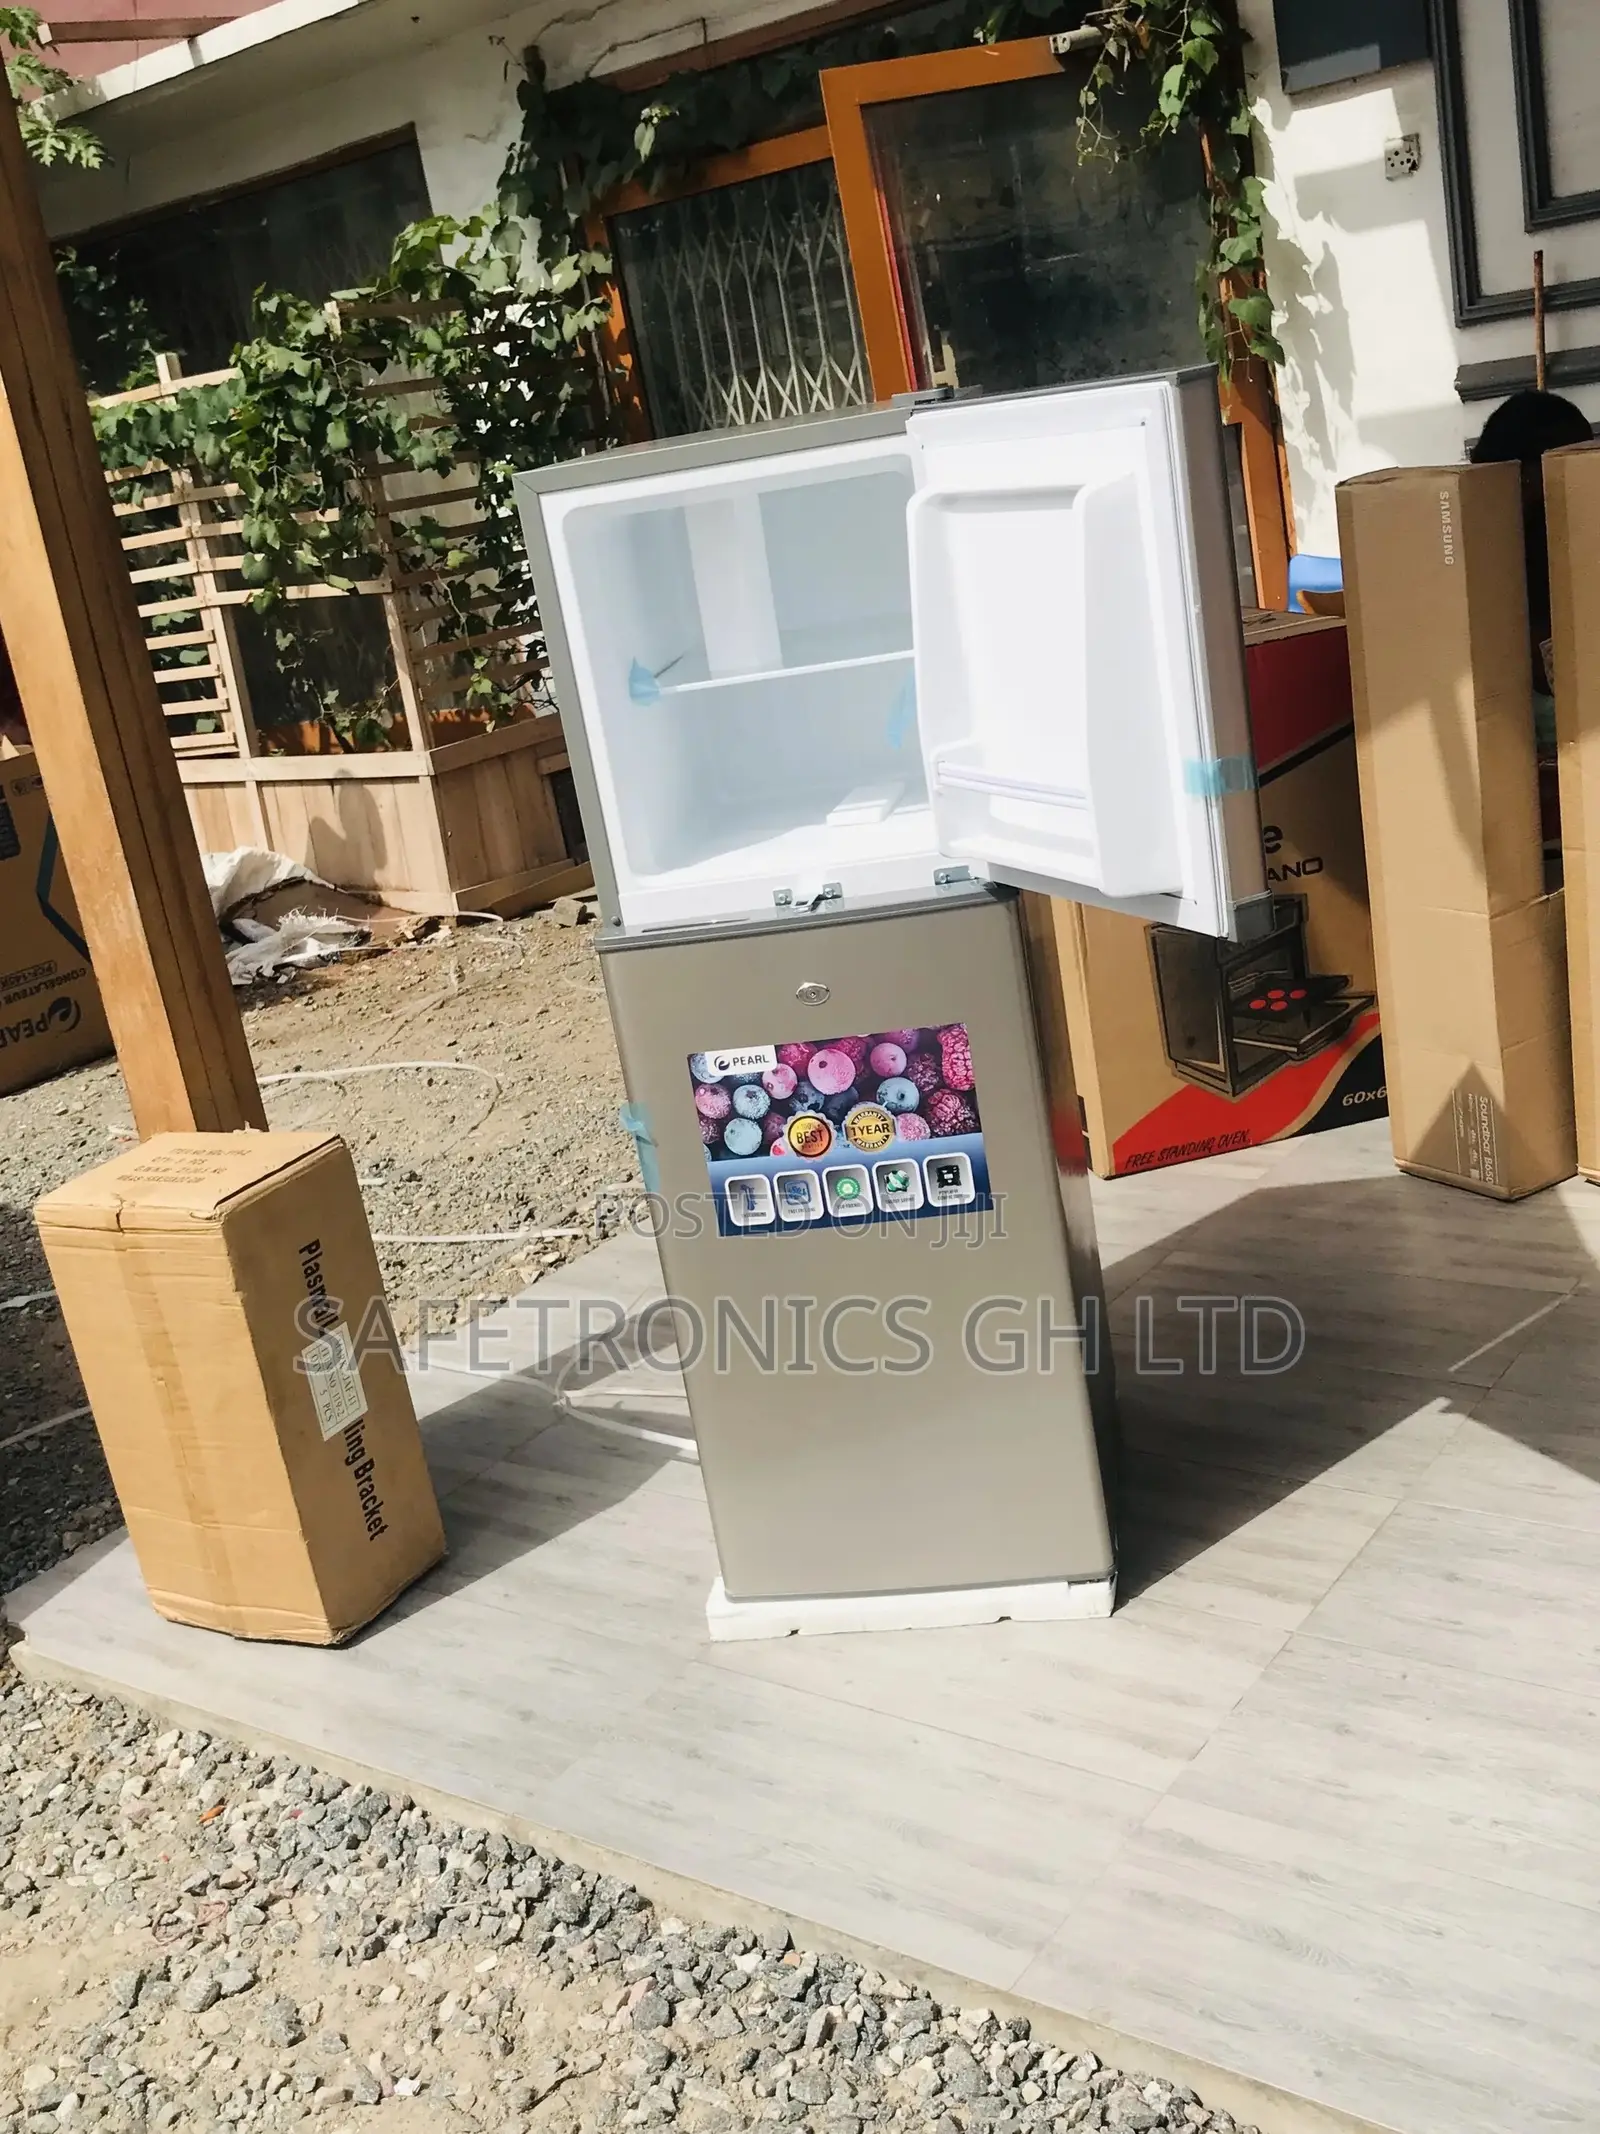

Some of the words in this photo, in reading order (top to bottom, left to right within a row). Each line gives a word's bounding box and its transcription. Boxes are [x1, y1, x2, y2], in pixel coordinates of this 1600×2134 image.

[1440, 491, 1454, 565] SAMSUNG
[1267, 856, 1324, 882] ANO
[732, 1054, 770, 1067] PEARL
[1342, 1085, 1387, 1107] 60x6
[796, 1129, 823, 1144] BEST
[858, 1122, 891, 1136] YEAR
[1479, 1095, 1491, 1157] Soundbar
[1124, 1151, 1155, 1170] FREE
[1157, 1134, 1216, 1162] STANDING
[353, 1457, 390, 1542] Bracket
